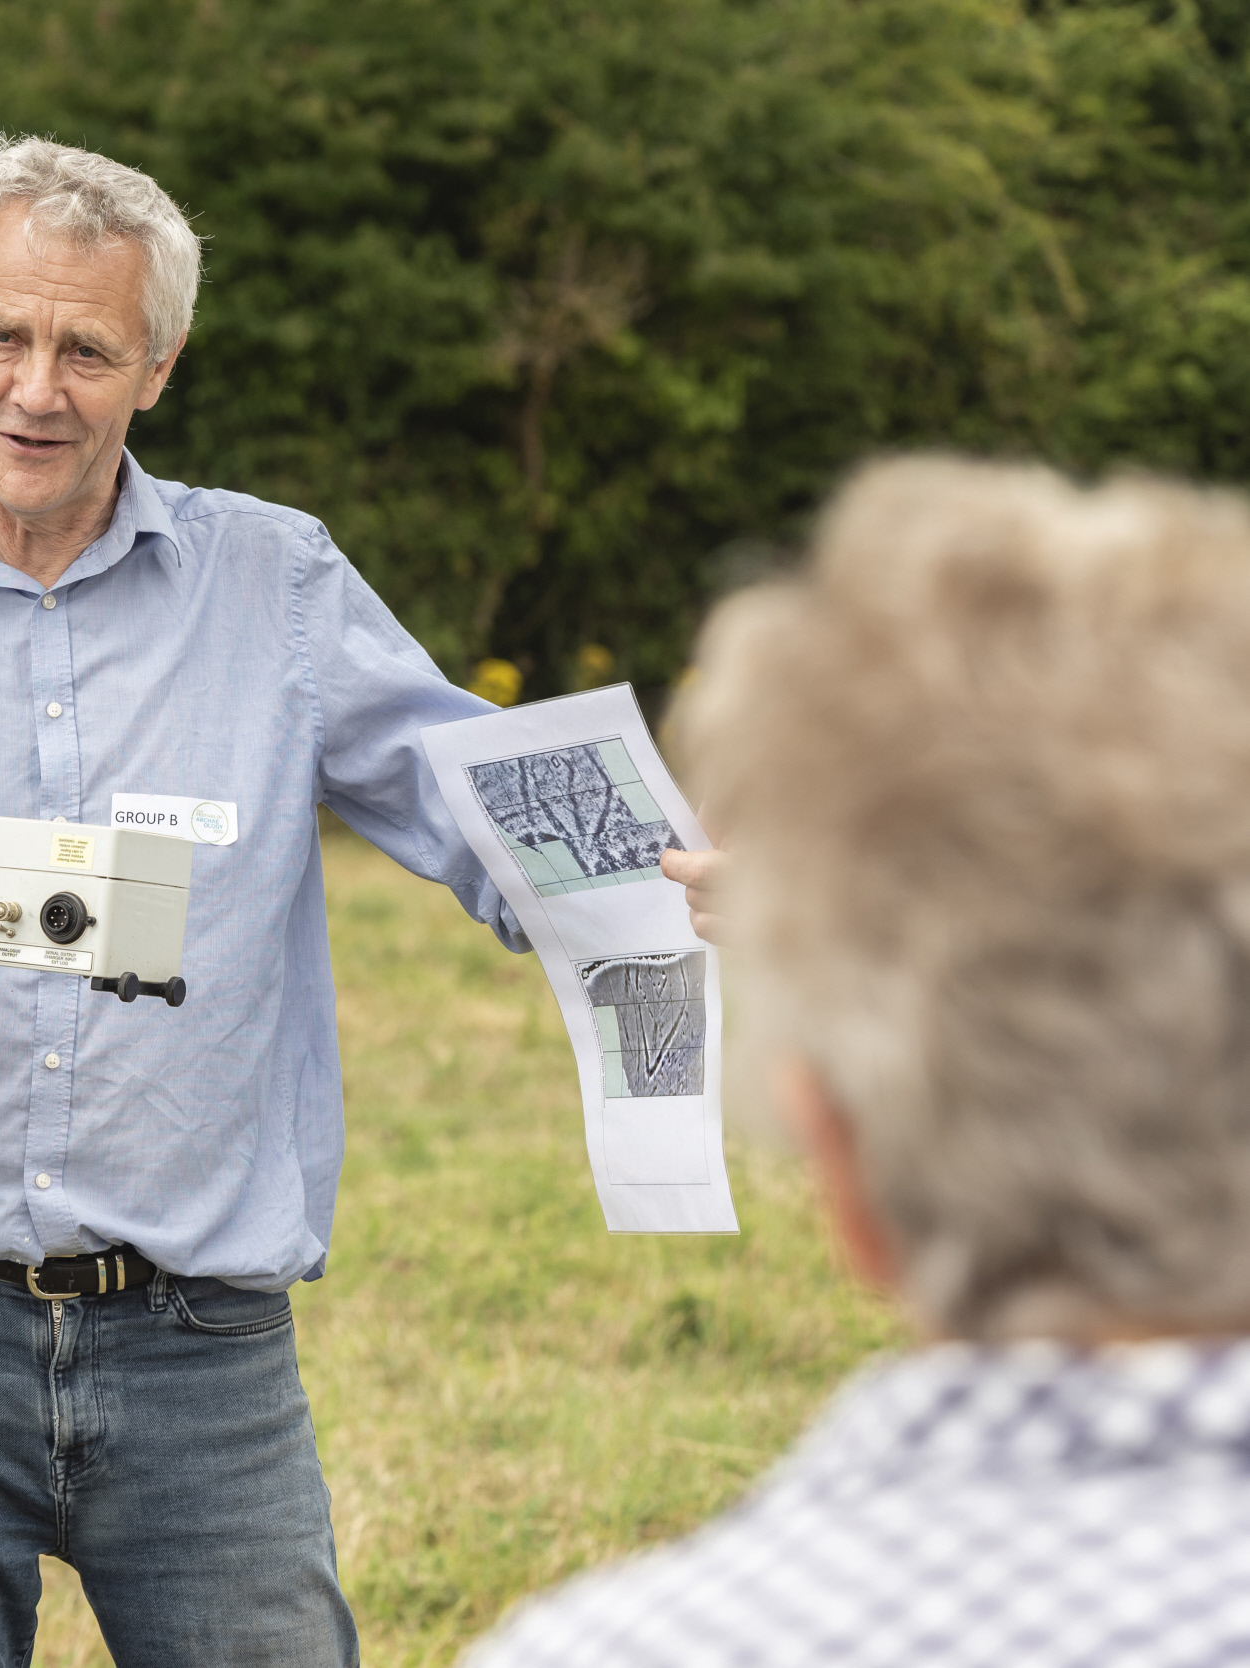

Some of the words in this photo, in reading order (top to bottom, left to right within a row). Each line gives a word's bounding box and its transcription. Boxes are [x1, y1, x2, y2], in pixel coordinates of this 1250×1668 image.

[115, 811, 165, 825] GROUP
[170, 814, 178, 826] B
[510, 854, 522, 870] British
[574, 964, 590, 1005] Magnetometry
